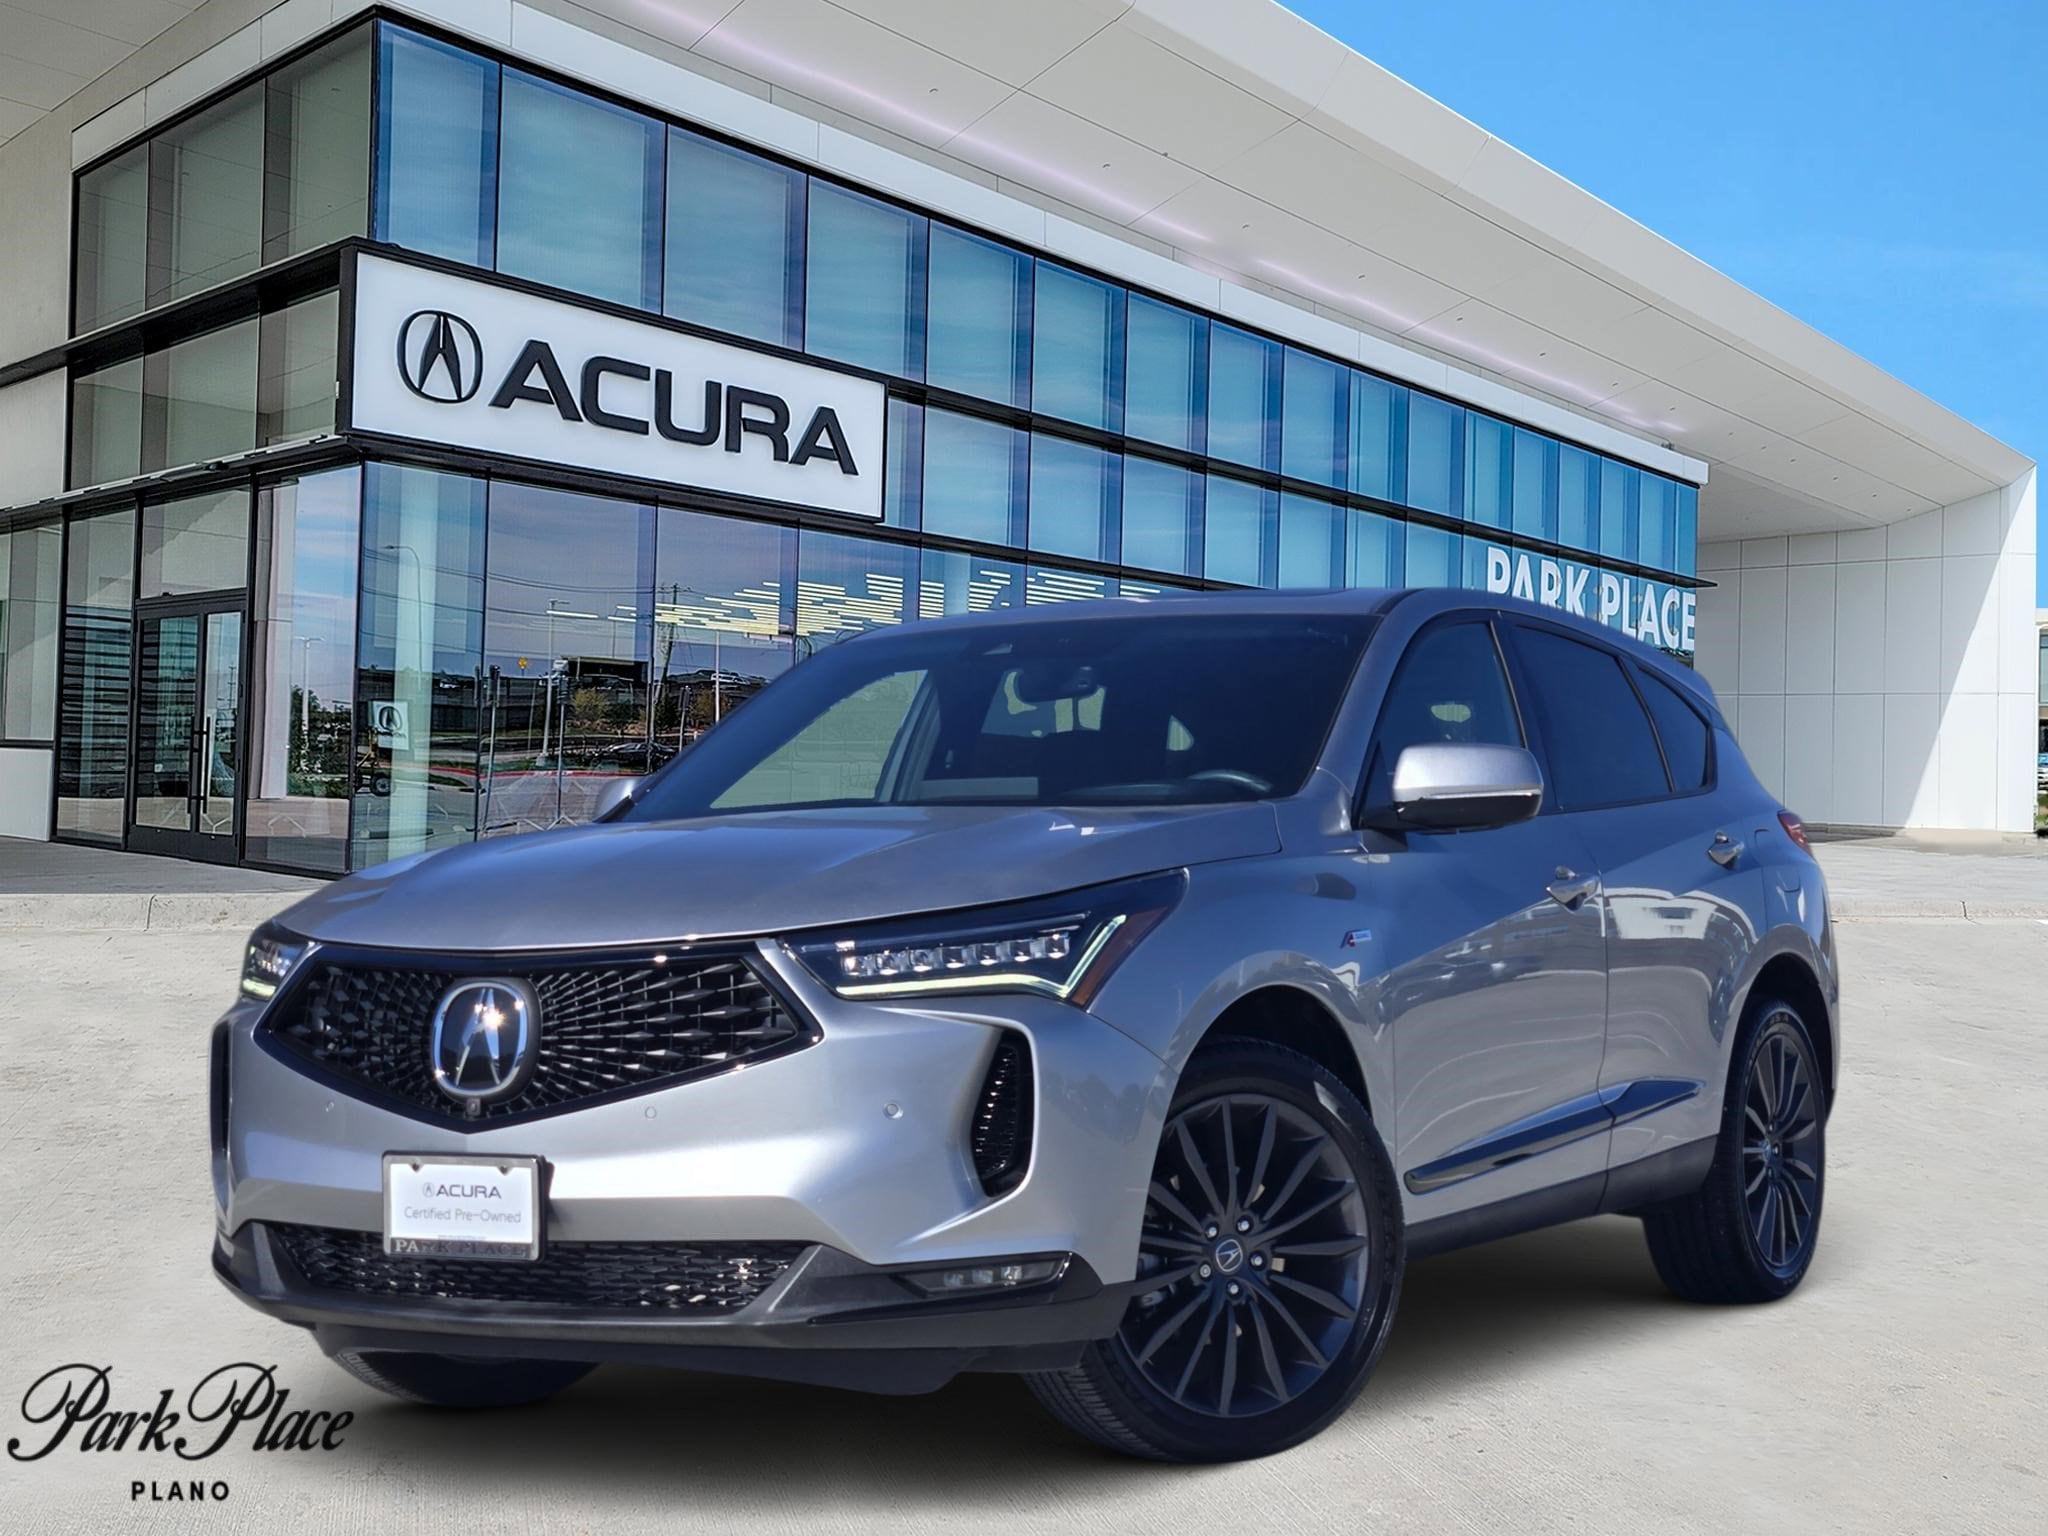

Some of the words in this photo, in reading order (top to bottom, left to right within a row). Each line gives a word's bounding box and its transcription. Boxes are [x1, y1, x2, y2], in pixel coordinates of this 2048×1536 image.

[489, 339, 859, 476] ACURA
[1487, 546, 1590, 618] PARK
[1601, 573, 1696, 650] PLACE
[404, 1206, 451, 1221] Certified
[455, 1208, 521, 1223] Pre-Owned
[436, 1184, 501, 1199] ACURA
